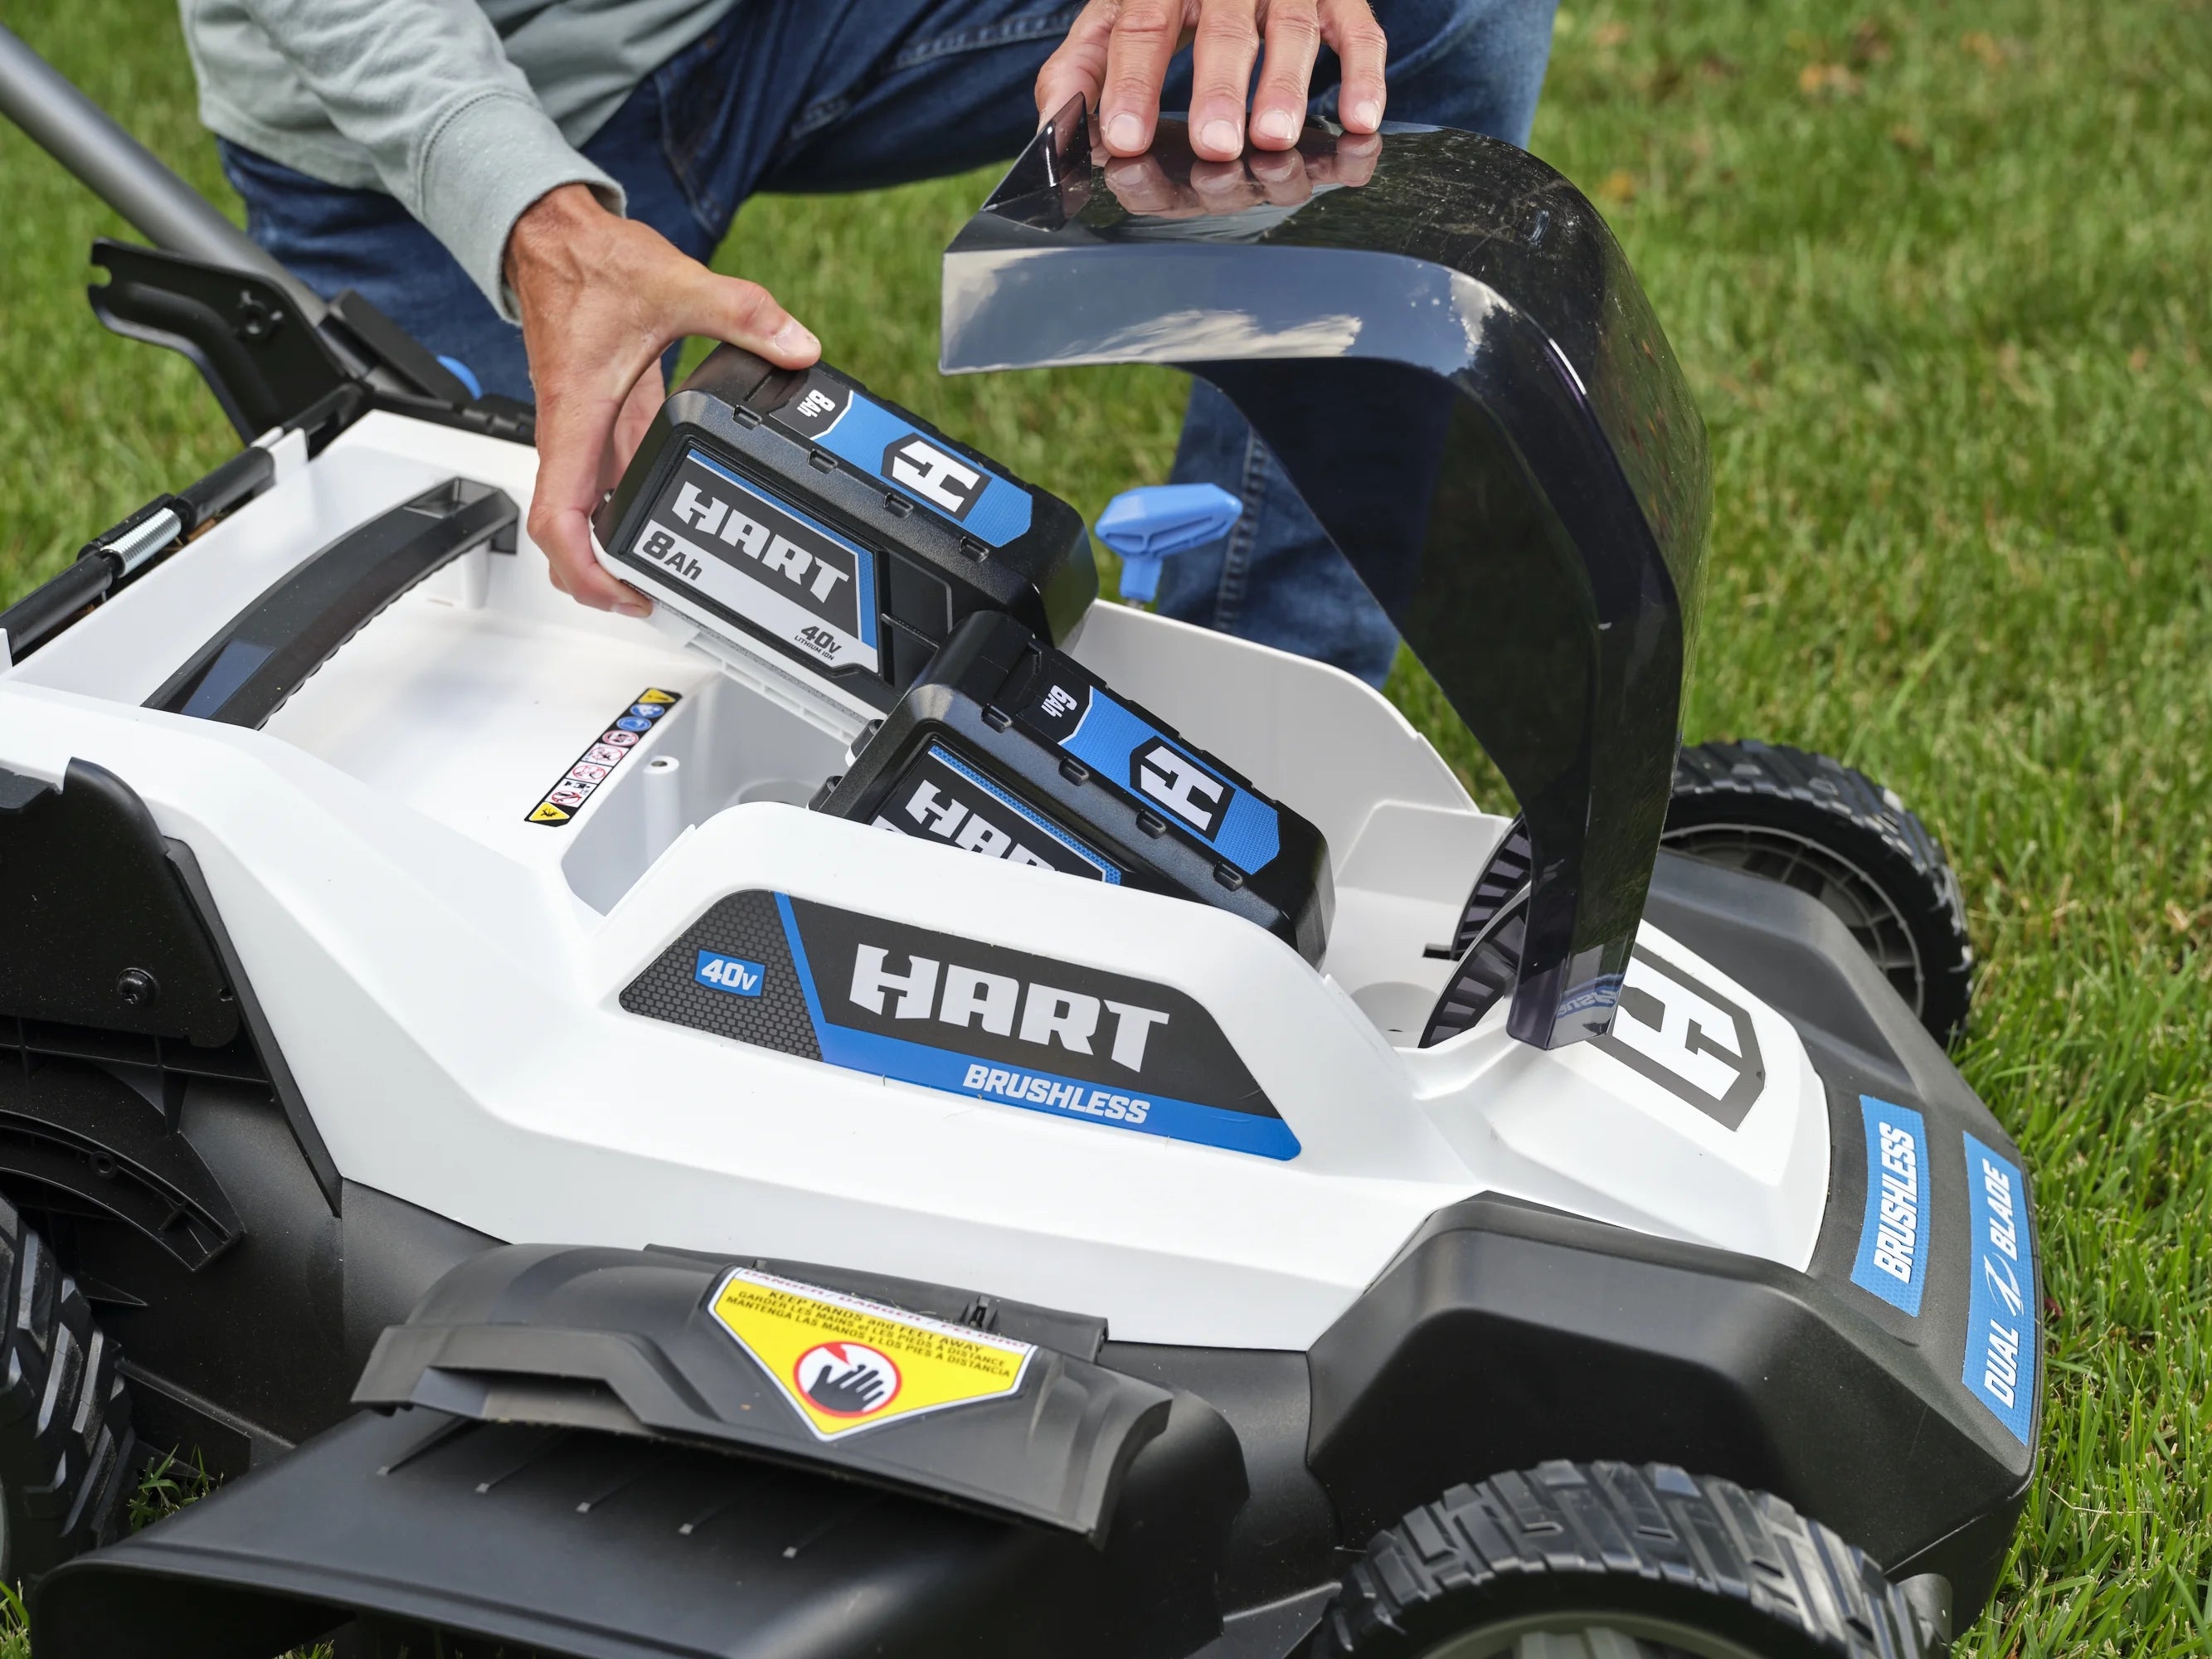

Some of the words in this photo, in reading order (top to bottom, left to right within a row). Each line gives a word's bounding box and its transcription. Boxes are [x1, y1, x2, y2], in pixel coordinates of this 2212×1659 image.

[797, 389, 836, 418] 8Ah
[642, 530, 703, 582] 8Ah
[672, 480, 850, 603] HART
[794, 635, 822, 654] LITHIUM
[1041, 684, 1078, 718] 6Ah
[848, 943, 1169, 1073] HART
[962, 1063, 1151, 1125] BRUSHLESS
[1873, 1121, 1918, 1285] BRUSHLESS
[1982, 1158, 2018, 1262] BLADE
[727, 1296, 793, 1320] MANTENGA
[795, 1316, 819, 1326] LAS
[821, 1322, 865, 1339] MANOS
[879, 1338, 902, 1350] LOS
[905, 1345, 931, 1357] PIES
[946, 1354, 1011, 1377] DISTANCIA
[738, 1291, 787, 1308] GARDER
[790, 1305, 812, 1316] LES
[815, 1311, 854, 1327] MAINS
[872, 1327, 894, 1338] LES
[898, 1334, 932, 1347] PIEDS
[947, 1347, 1005, 1367] DISTANCE
[769, 1291, 808, 1306] KEEP
[811, 1301, 863, 1321] HANDS
[868, 1319, 896, 1331] and
[899, 1326, 935, 1340] FEET
[939, 1337, 983, 1353] AWAY
[1983, 1319, 2020, 1410] DUAL
